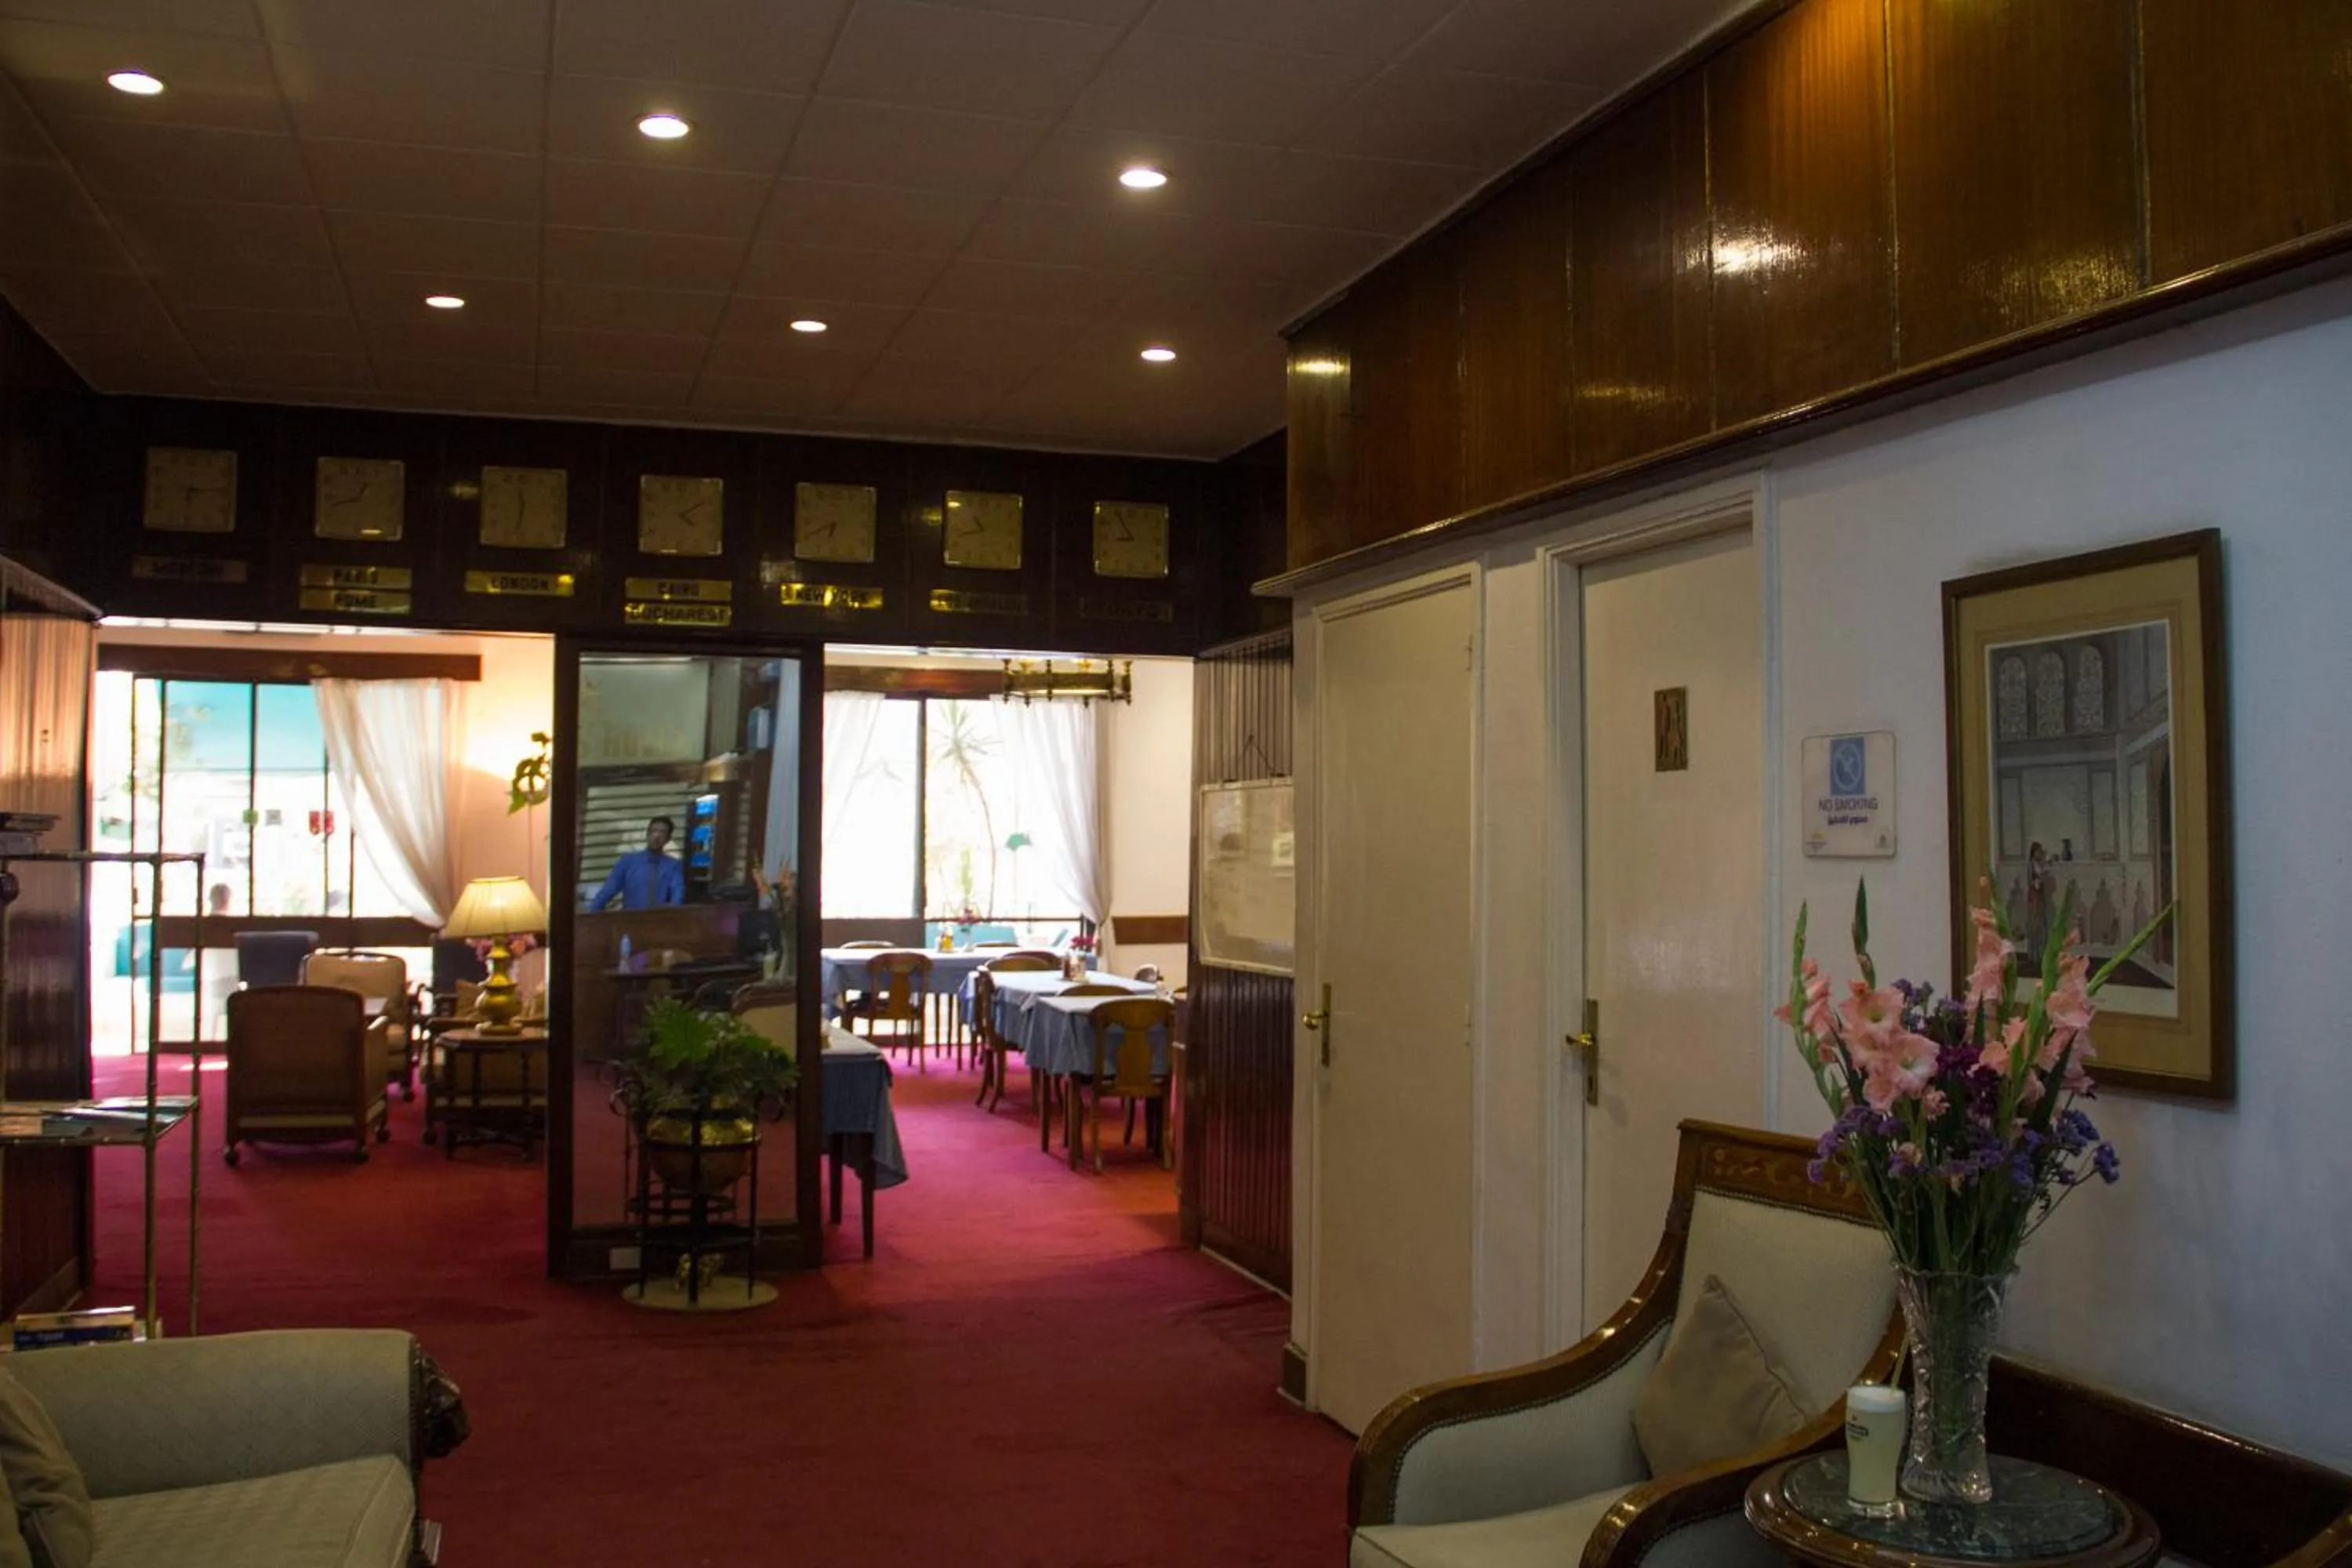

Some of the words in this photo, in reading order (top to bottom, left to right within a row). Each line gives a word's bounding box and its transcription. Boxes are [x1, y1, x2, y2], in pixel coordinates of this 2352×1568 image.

[490, 575, 549, 591] LONDON
[795, 587, 824, 603] NEW
[630, 604, 724, 622] BUCHAREST
[1818, 799, 1833, 811] NO
[1835, 797, 1878, 811] SMOKING
